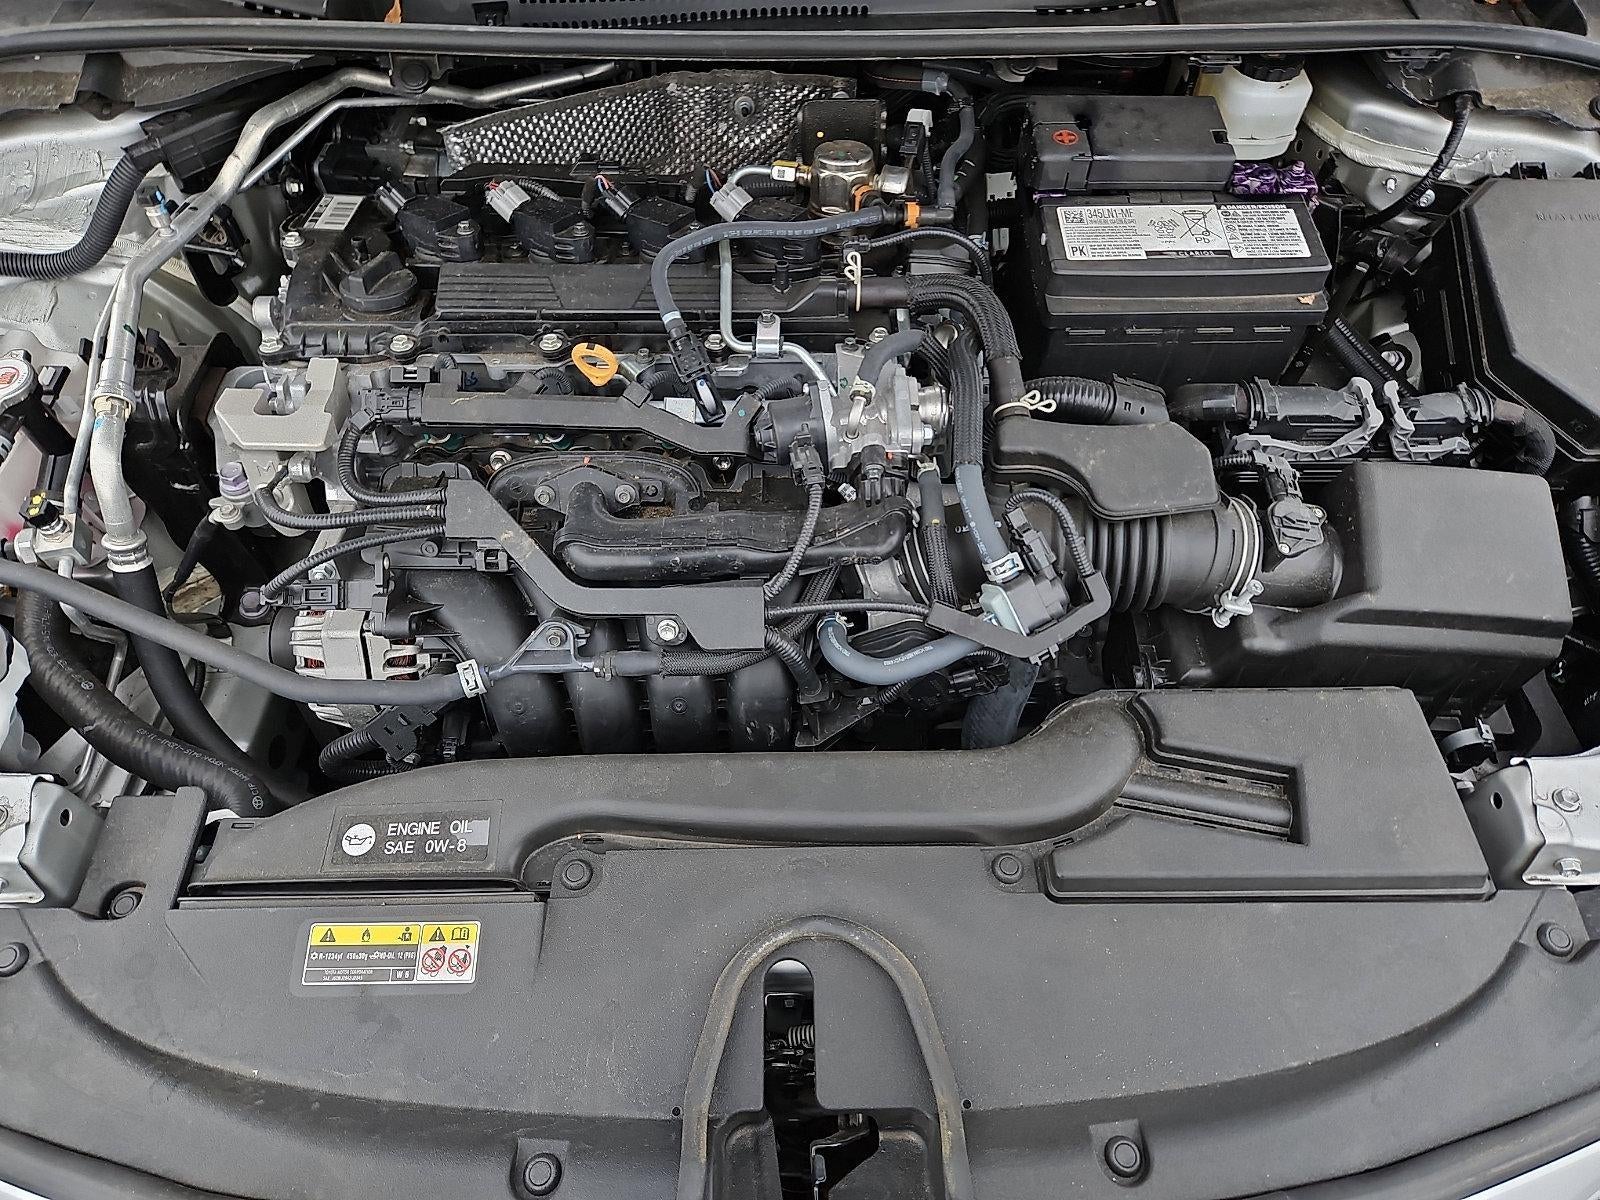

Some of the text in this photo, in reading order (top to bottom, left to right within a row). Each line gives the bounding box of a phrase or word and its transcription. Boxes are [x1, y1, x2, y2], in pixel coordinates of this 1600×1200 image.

[1087, 208, 1134, 219] 345LN1-MF
[1071, 246, 1086, 257] PK
[387, 819, 473, 836] ENGINE OIL
[384, 838, 467, 855] SAE 0W-8
[396, 970, 403, 979] W
